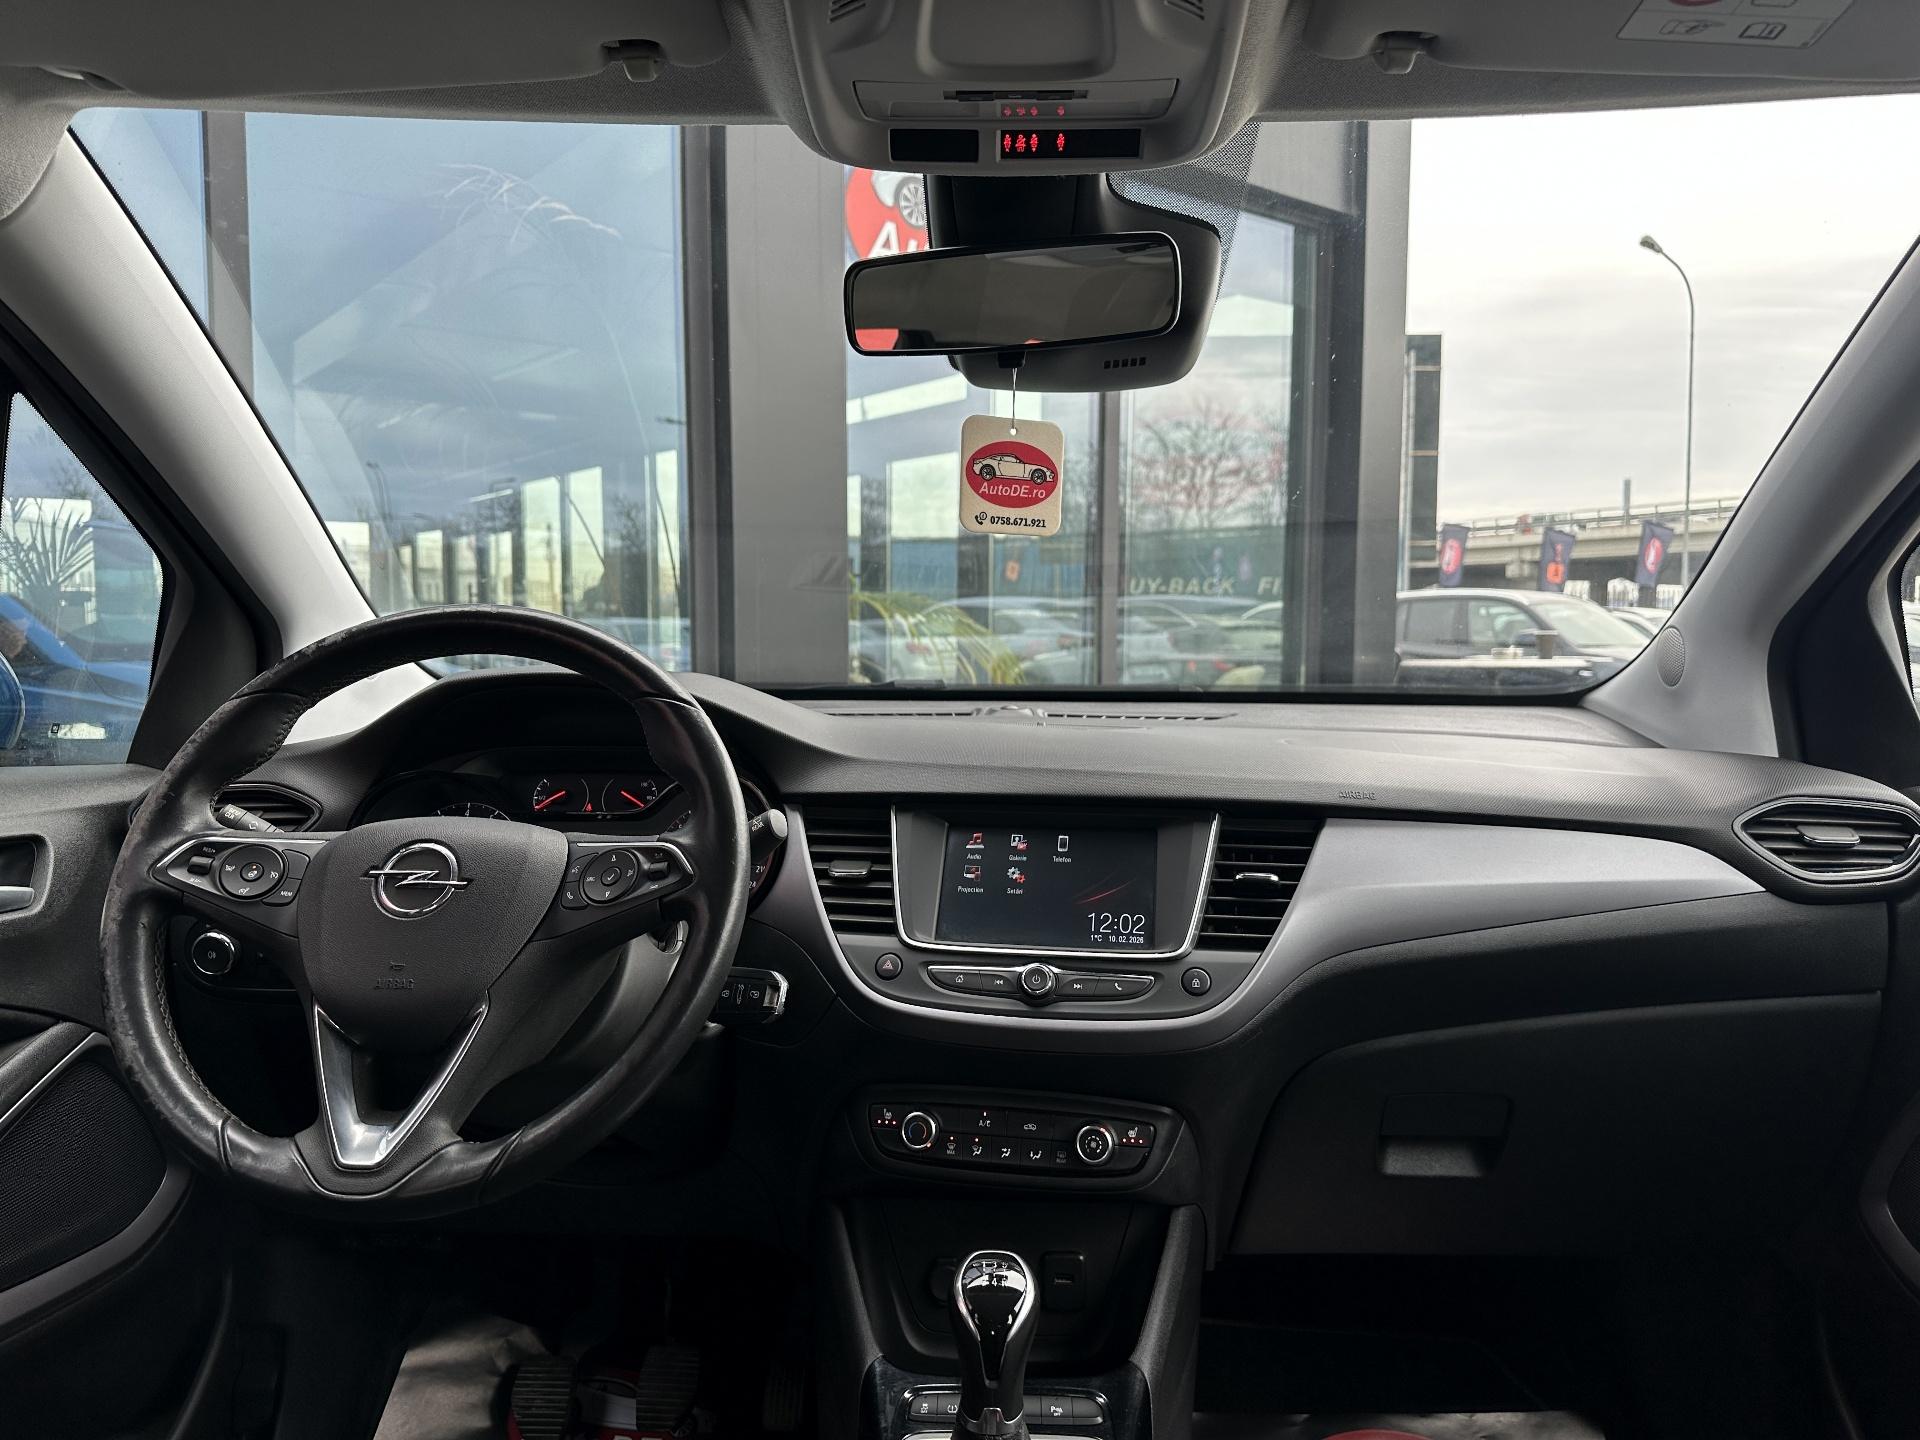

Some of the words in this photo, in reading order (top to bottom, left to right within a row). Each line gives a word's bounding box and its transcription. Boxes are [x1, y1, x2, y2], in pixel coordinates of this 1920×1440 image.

[979, 482, 1046, 499] AutoDE.ro
[990, 515, 1047, 528] 0758.671.921
[1339, 790, 1376, 800] AIRBAG
[958, 886, 984, 894] Projection
[1088, 912, 1145, 934] 12:02
[978, 1120, 991, 1128] A/C
